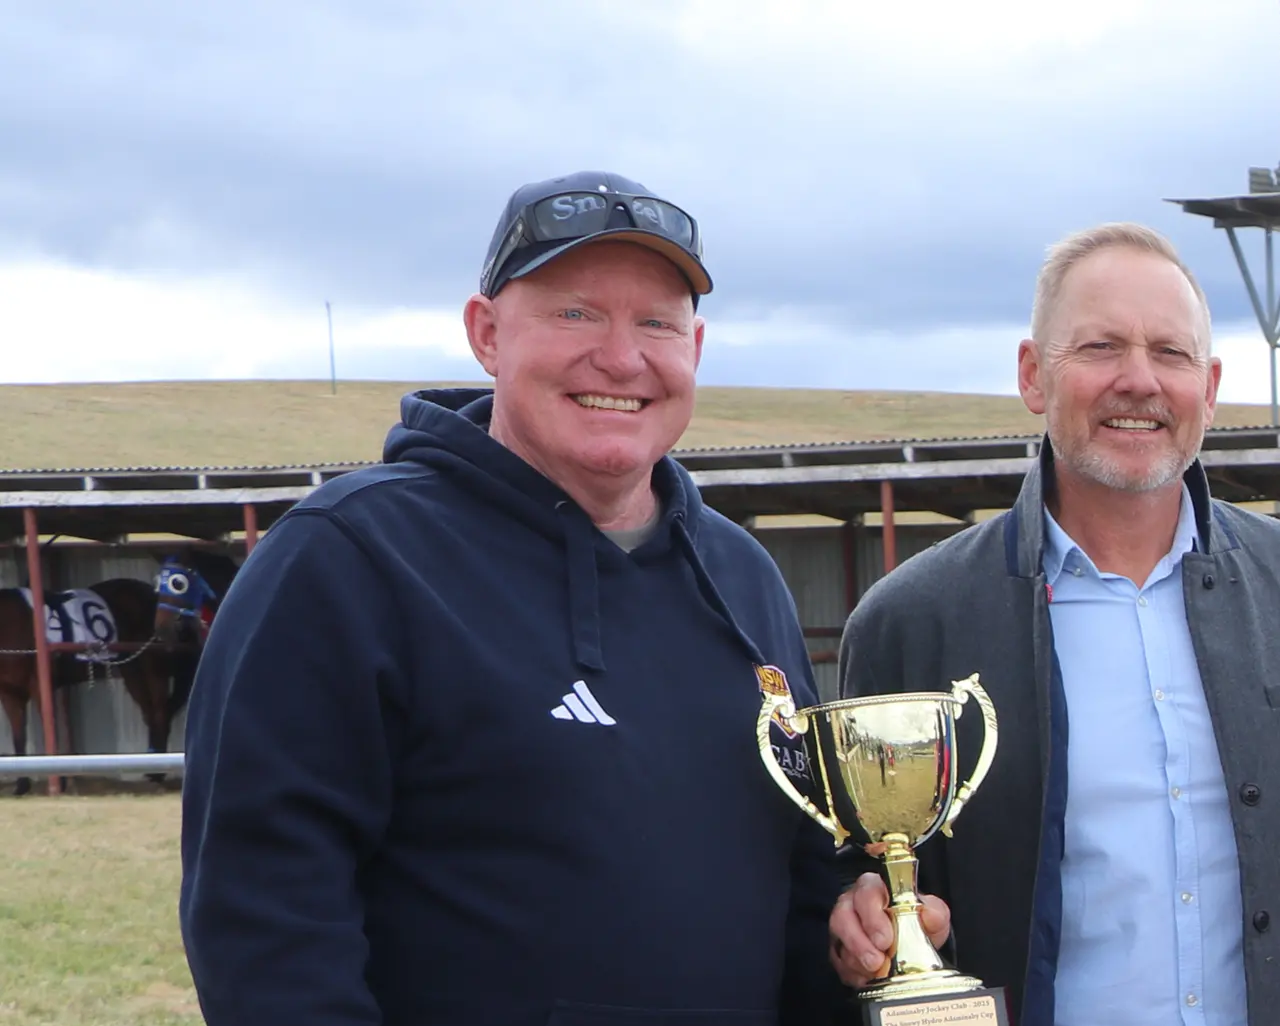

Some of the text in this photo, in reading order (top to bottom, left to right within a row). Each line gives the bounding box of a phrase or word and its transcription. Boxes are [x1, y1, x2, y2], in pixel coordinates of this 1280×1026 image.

[886, 1007, 925, 1018] Adaminaby
[926, 1004, 949, 1015] Jockey
[951, 1001, 968, 1011] Club
[922, 1016, 943, 1026] Hydro
[944, 1012, 979, 1023] Adaminaby
[980, 1011, 994, 1020] Cup
